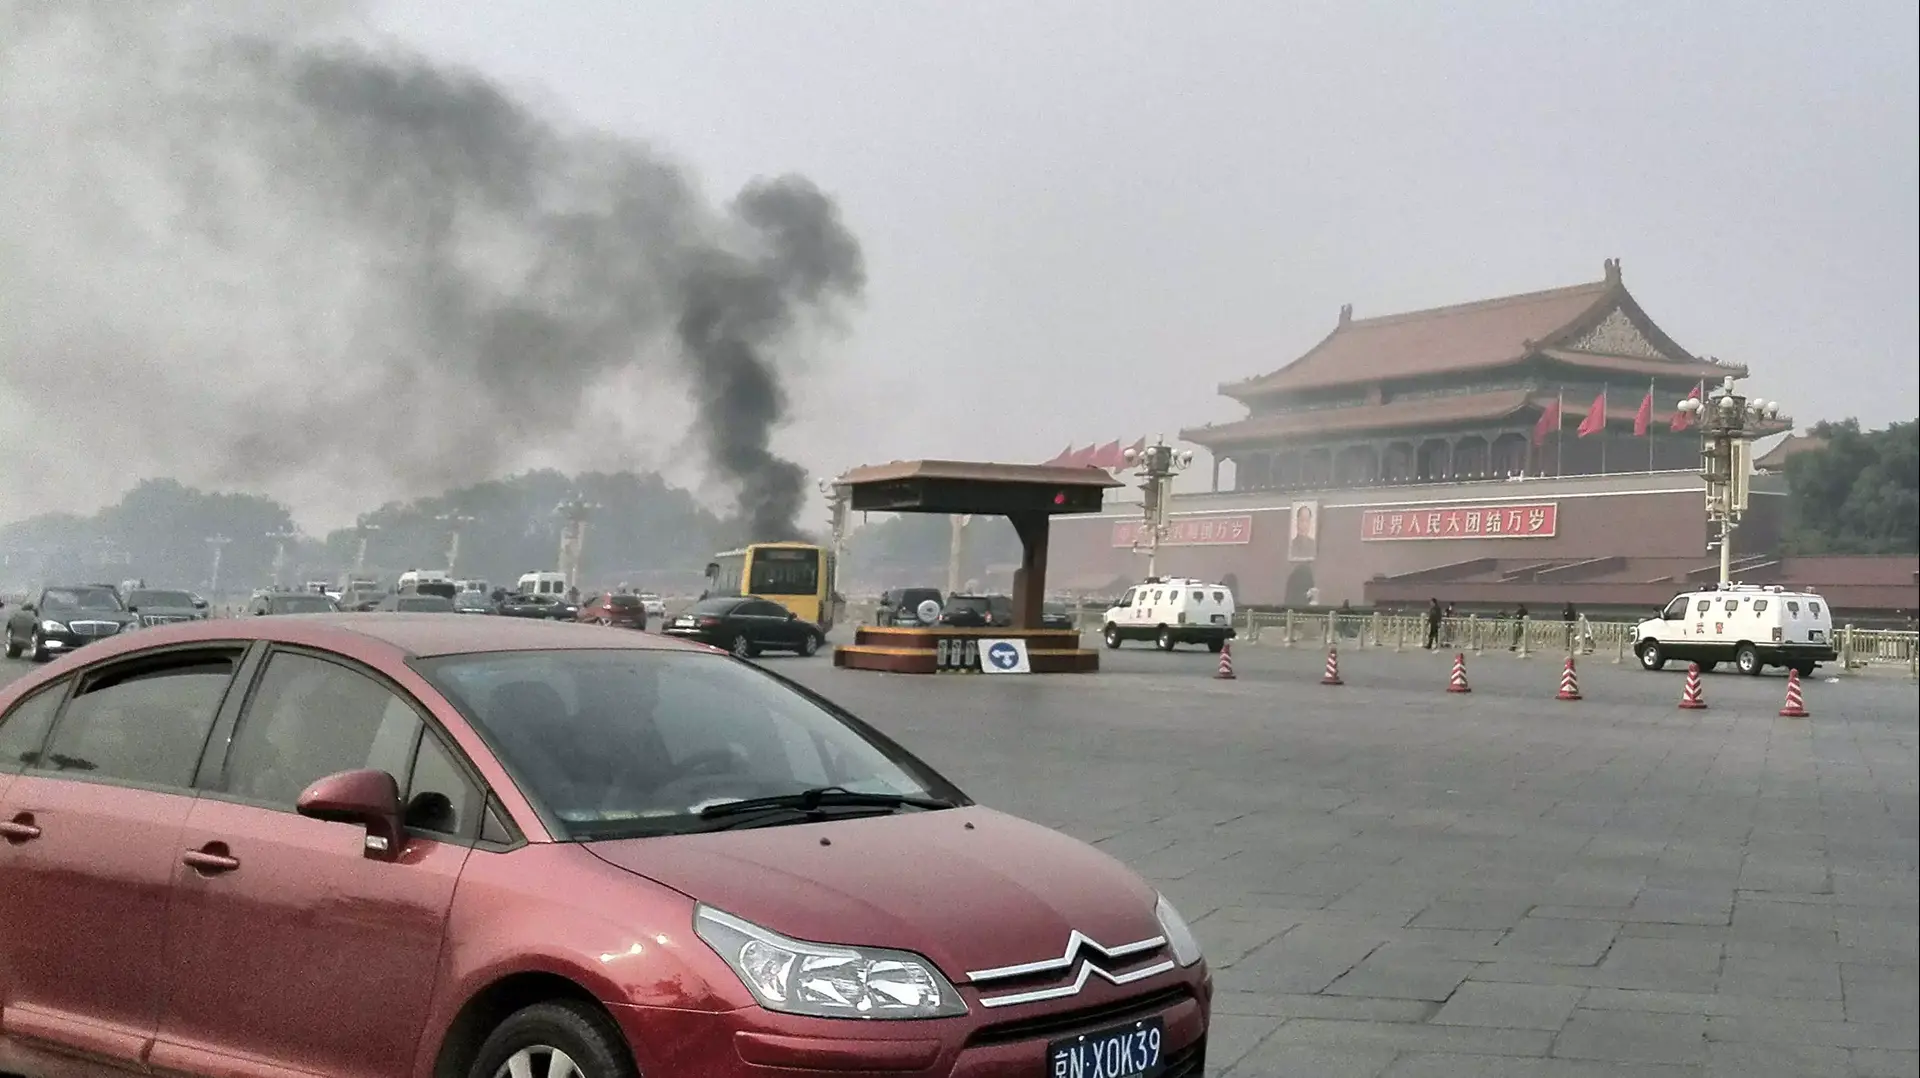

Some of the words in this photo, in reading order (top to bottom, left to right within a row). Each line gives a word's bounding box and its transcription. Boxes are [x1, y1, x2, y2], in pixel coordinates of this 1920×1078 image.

[1372, 509, 1545, 535] 世界人民大团结万岁
